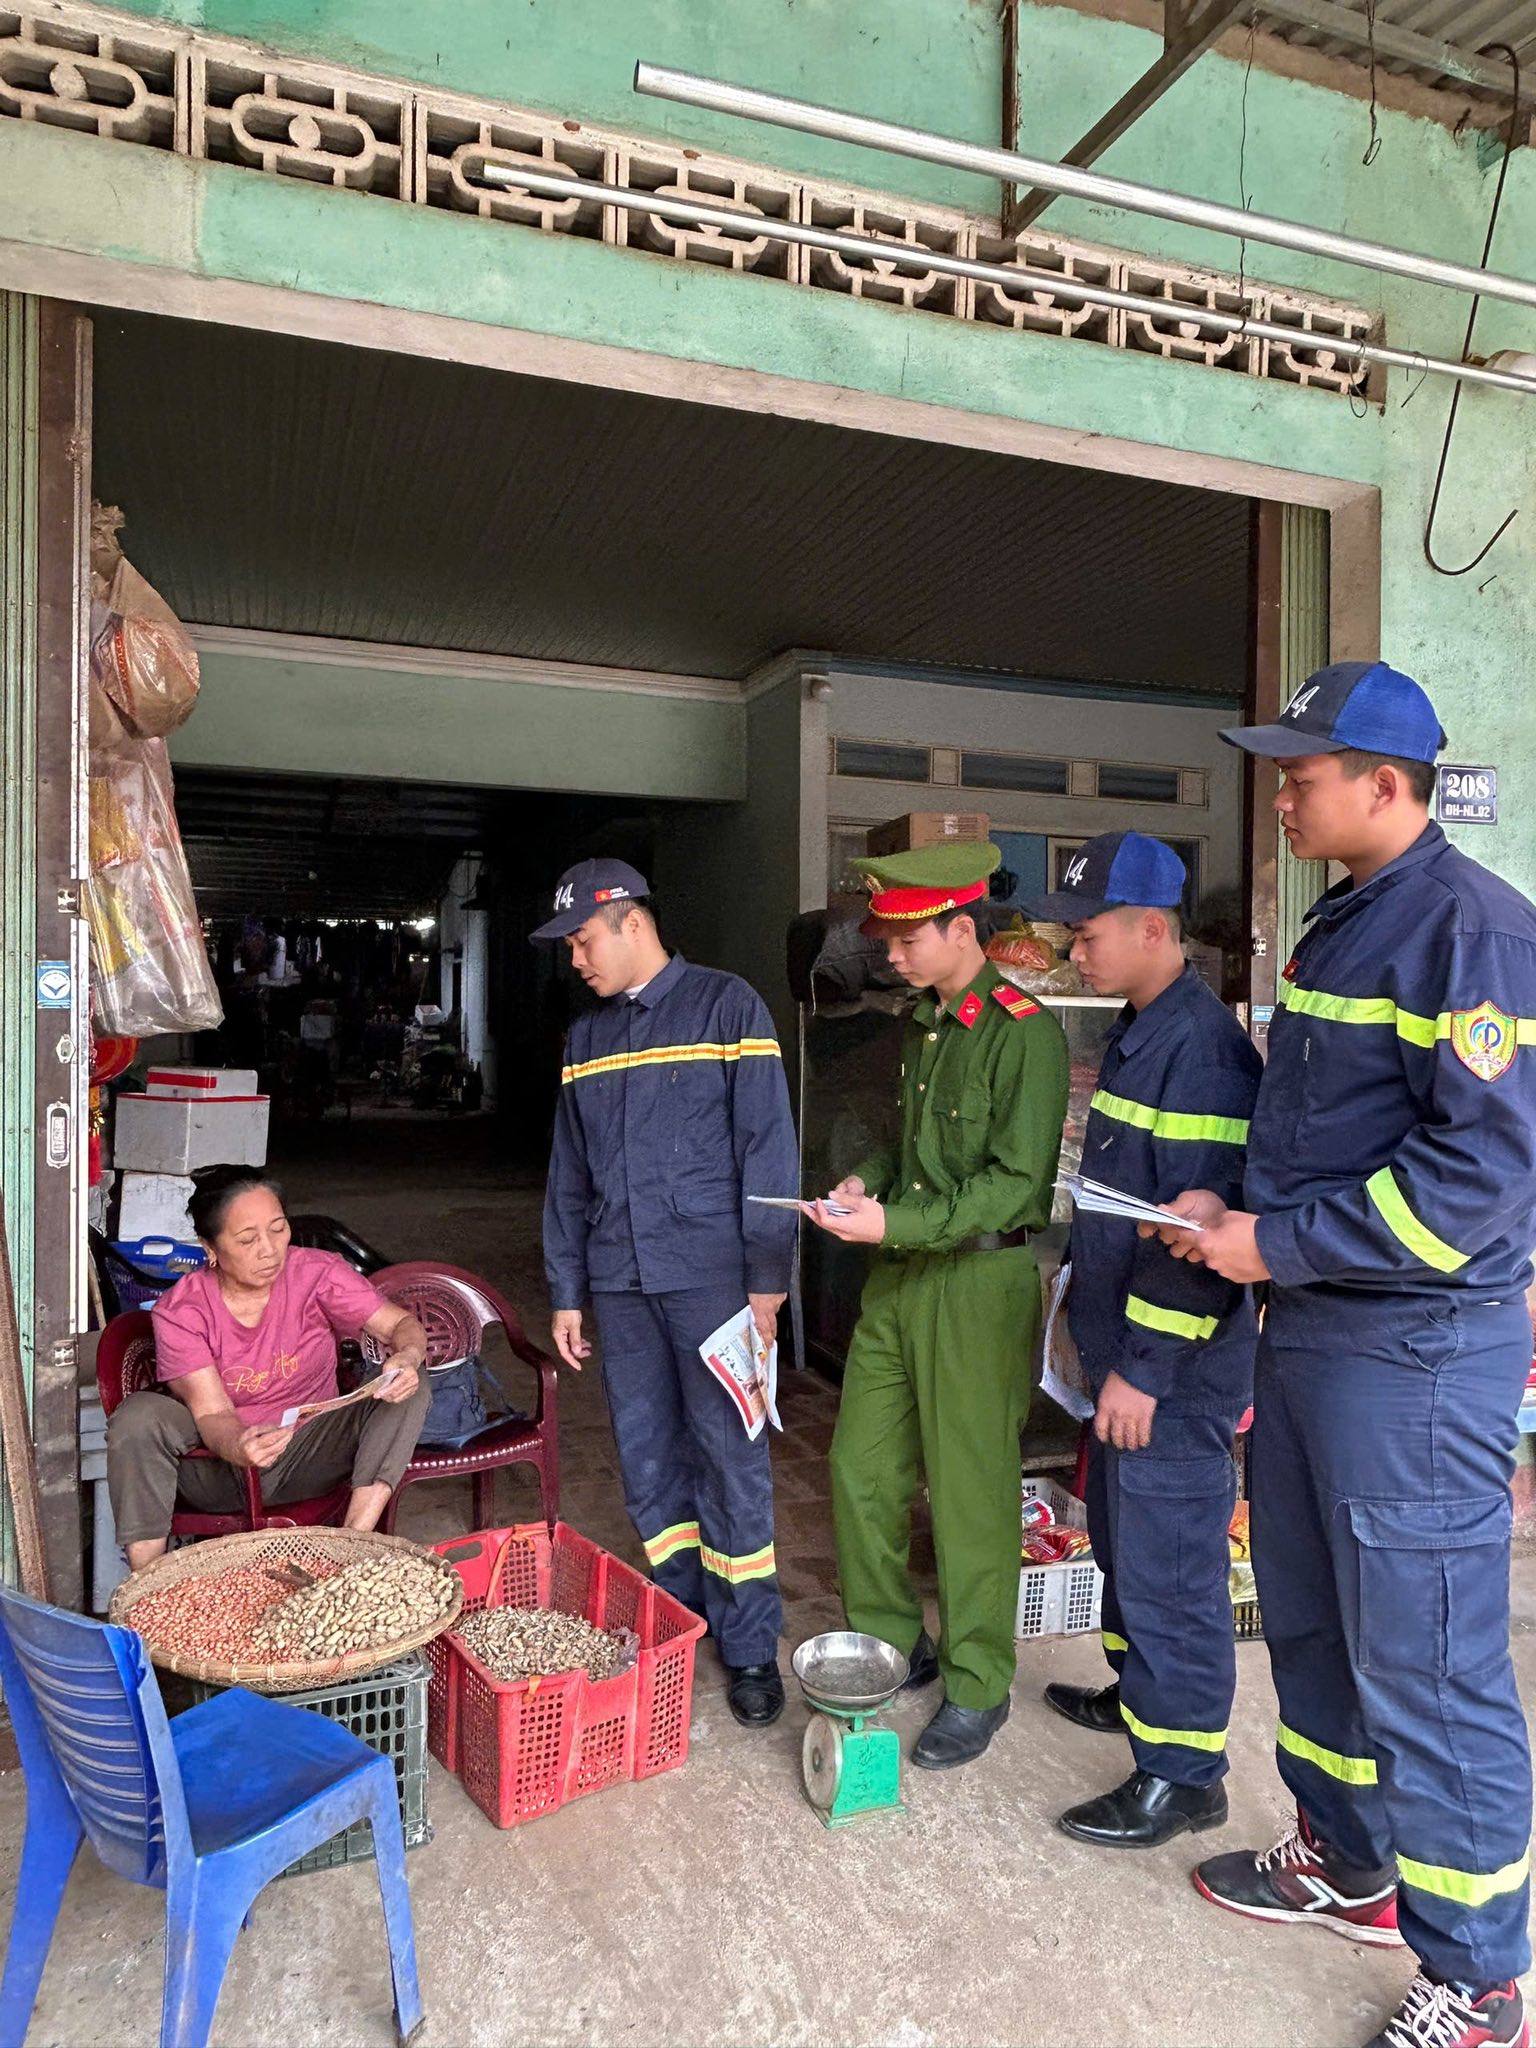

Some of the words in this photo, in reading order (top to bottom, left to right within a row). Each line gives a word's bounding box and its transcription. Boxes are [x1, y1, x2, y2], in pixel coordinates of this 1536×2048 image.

[1446, 773, 1490, 799] 208
[1064, 854, 1089, 887] 14
[553, 882, 575, 911] 14
